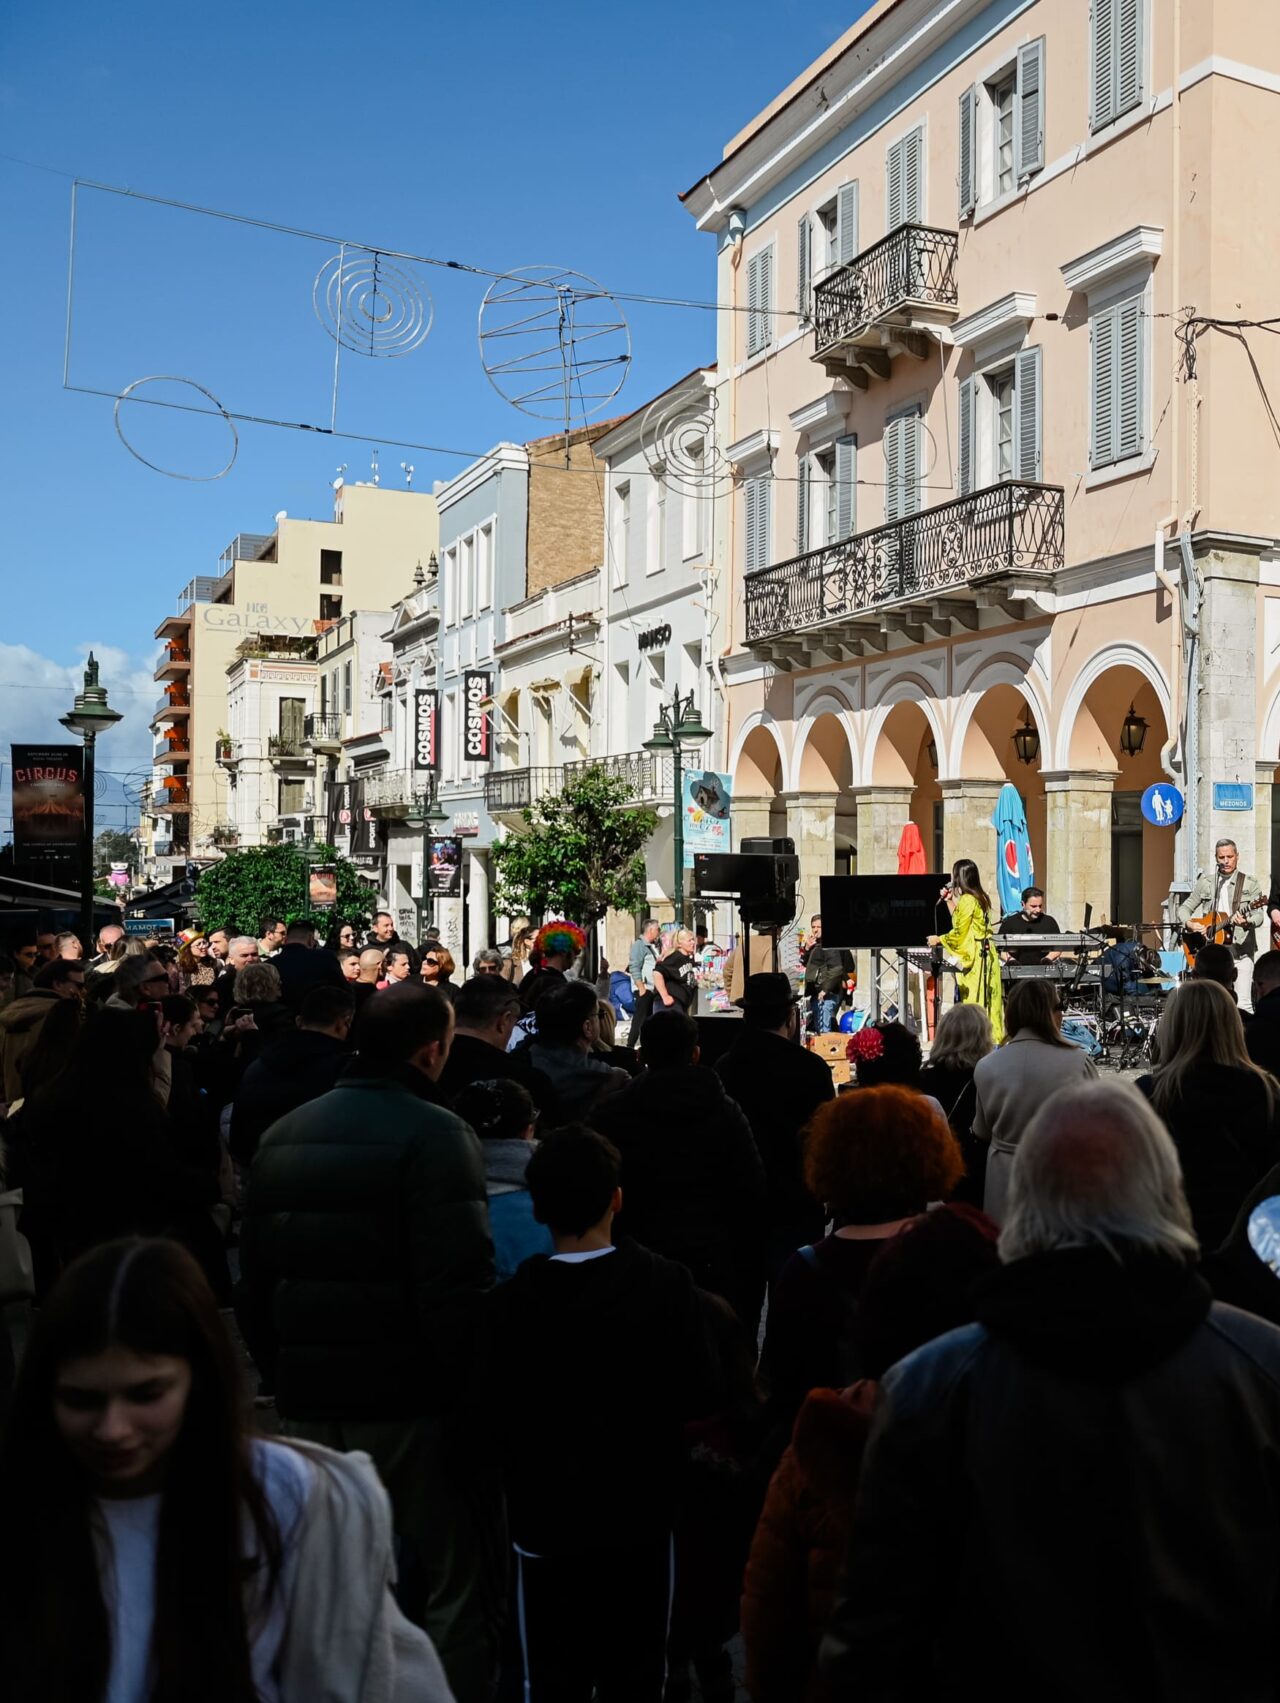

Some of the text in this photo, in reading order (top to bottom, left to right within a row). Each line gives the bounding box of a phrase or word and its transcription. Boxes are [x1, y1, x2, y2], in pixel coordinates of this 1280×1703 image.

[417, 694, 431, 765] COSMOS
[467, 676, 482, 755] COSMOS
[15, 766, 78, 783] CIRCUS
